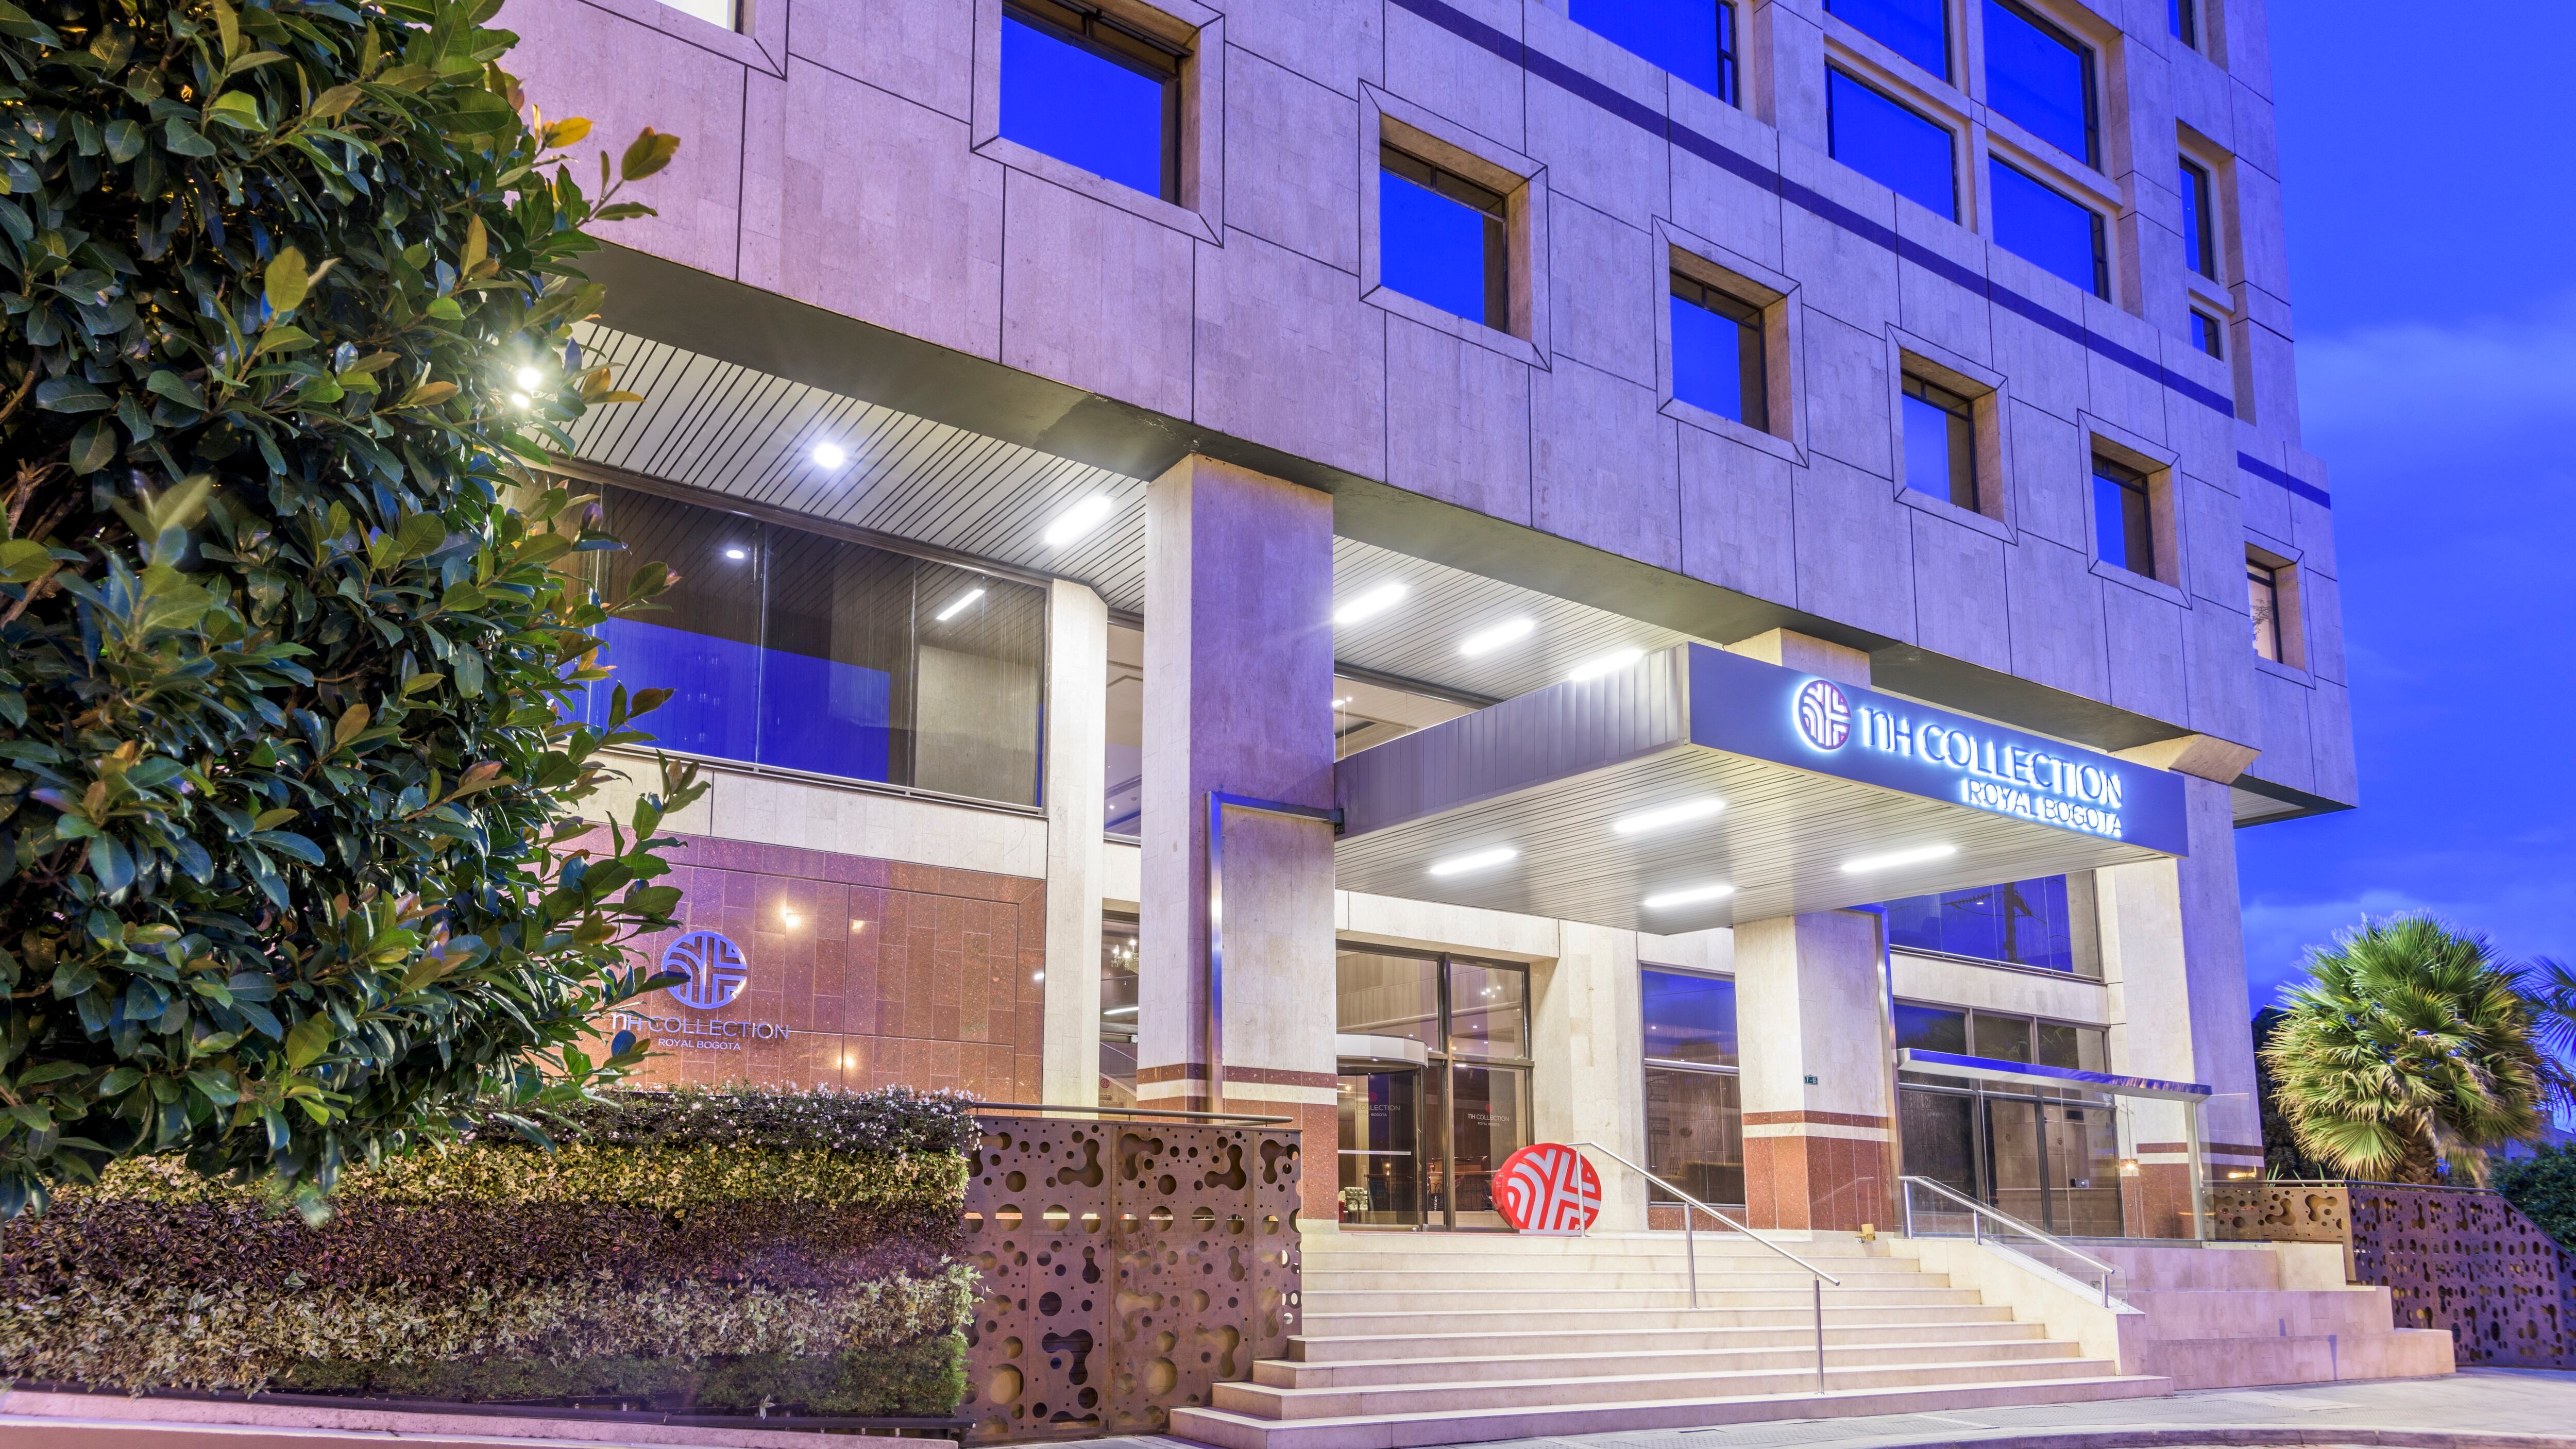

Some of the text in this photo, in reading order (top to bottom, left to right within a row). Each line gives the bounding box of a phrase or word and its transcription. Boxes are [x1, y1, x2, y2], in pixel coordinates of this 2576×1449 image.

[1918, 724, 2123, 808] COLLECTION
[1962, 779, 2123, 837] ROYAL BOGOTA
[648, 1016, 789, 1039] COLLECTION
[658, 1038, 741, 1050] ROYAL BOGOTA
